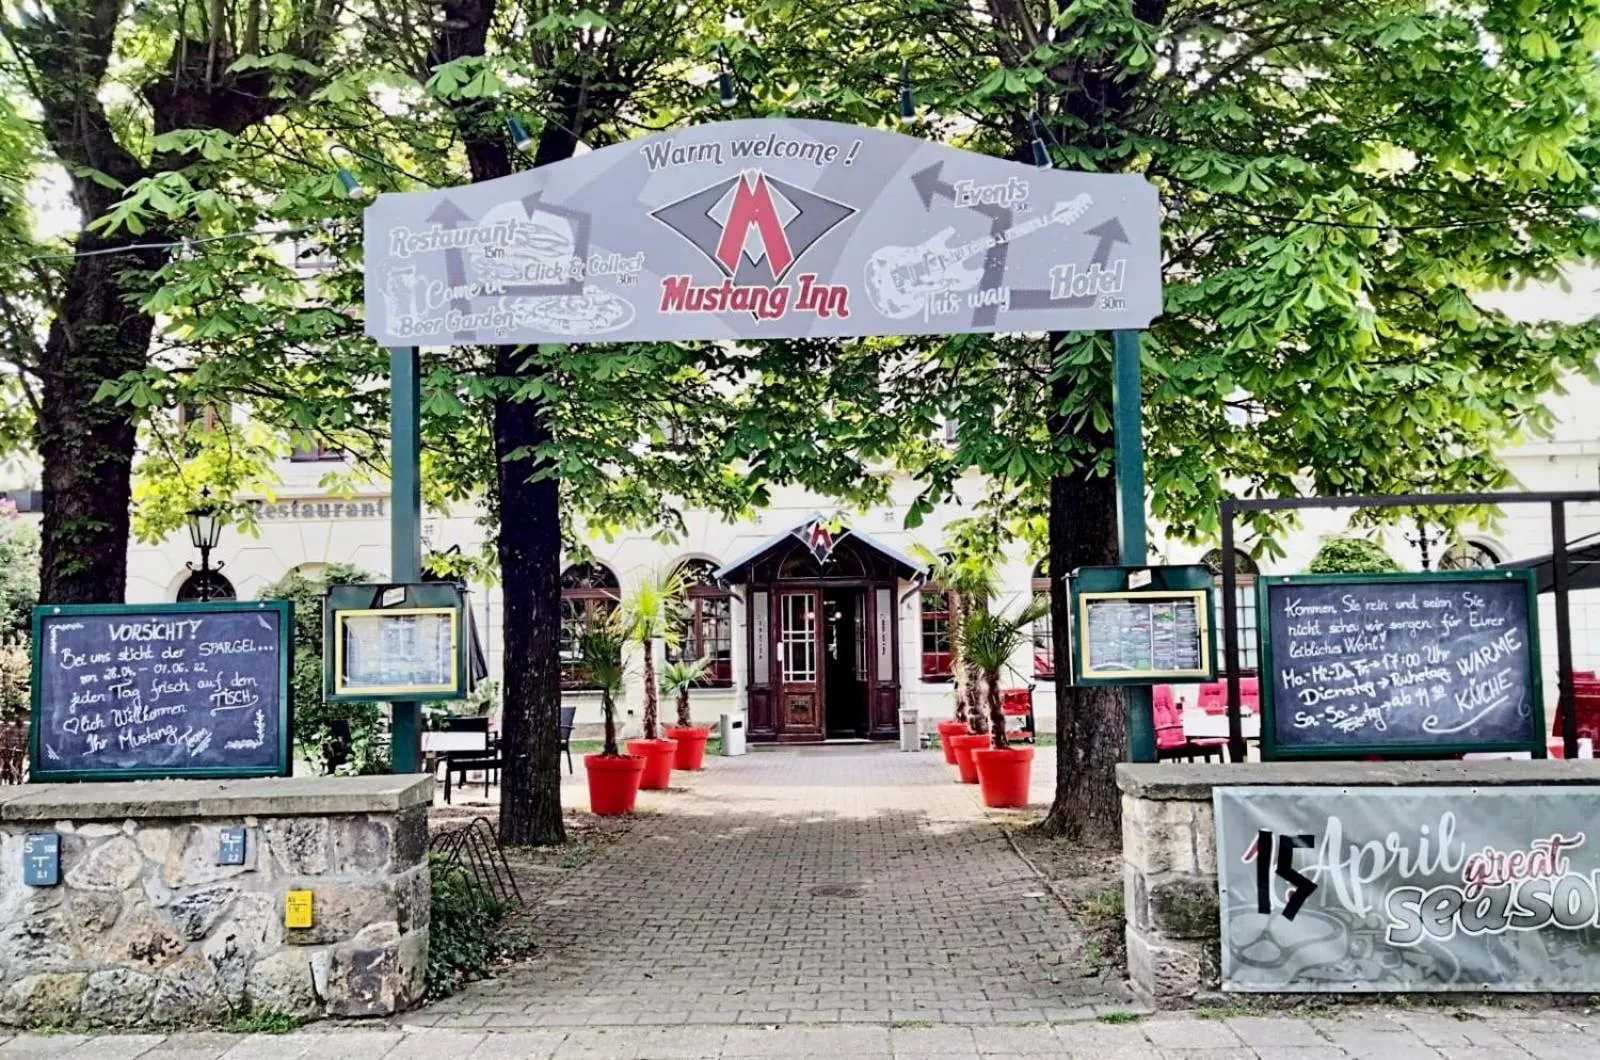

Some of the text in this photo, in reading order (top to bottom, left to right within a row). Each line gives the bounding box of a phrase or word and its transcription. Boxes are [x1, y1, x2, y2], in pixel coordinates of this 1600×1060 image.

[641, 140, 724, 171] Warm
[730, 133, 839, 166] welcome
[953, 176, 1030, 209] Events
[389, 216, 518, 258] Restaurant
[483, 246, 505, 259] 15m
[524, 250, 646, 282] Click & Collect
[1050, 259, 1127, 300] Hotel
[424, 279, 481, 310] Come
[658, 272, 850, 320] Mustang Inn
[967, 285, 1011, 313] way
[1100, 295, 1127, 312] 30m
[398, 305, 519, 338] Beer Garden
[1285, 597, 1338, 618] Kommen
[1342, 594, 1362, 614] Sie
[1365, 599, 1389, 612] rein
[1395, 594, 1419, 611] und
[1463, 592, 1486, 608] Sie
[1288, 620, 1322, 637] nicht
[1364, 619, 1385, 632] wir
[1388, 617, 1433, 638] sorgen
[1441, 612, 1463, 637] für
[60, 648, 88, 670] Bei
[91, 652, 112, 664] uns
[117, 646, 154, 662] sticht
[160, 646, 185, 659] der
[1381, 651, 1421, 671] 17:00
[1422, 644, 1451, 665] Uhr
[1455, 627, 1522, 677] WARME
[69, 690, 106, 714] jeden
[108, 678, 142, 706] Tag
[150, 678, 191, 702] frisch
[197, 671, 223, 692] auf
[1298, 666, 1453, 706] Dienstag Ruhetag
[1391, 688, 1412, 707] ab
[1454, 667, 1514, 715] KÜCHE
[110, 703, 189, 728] Willkommen
[118, 724, 179, 751] Mustang
[1298, 810, 1586, 919] April great
[1385, 866, 1600, 947] seaso
